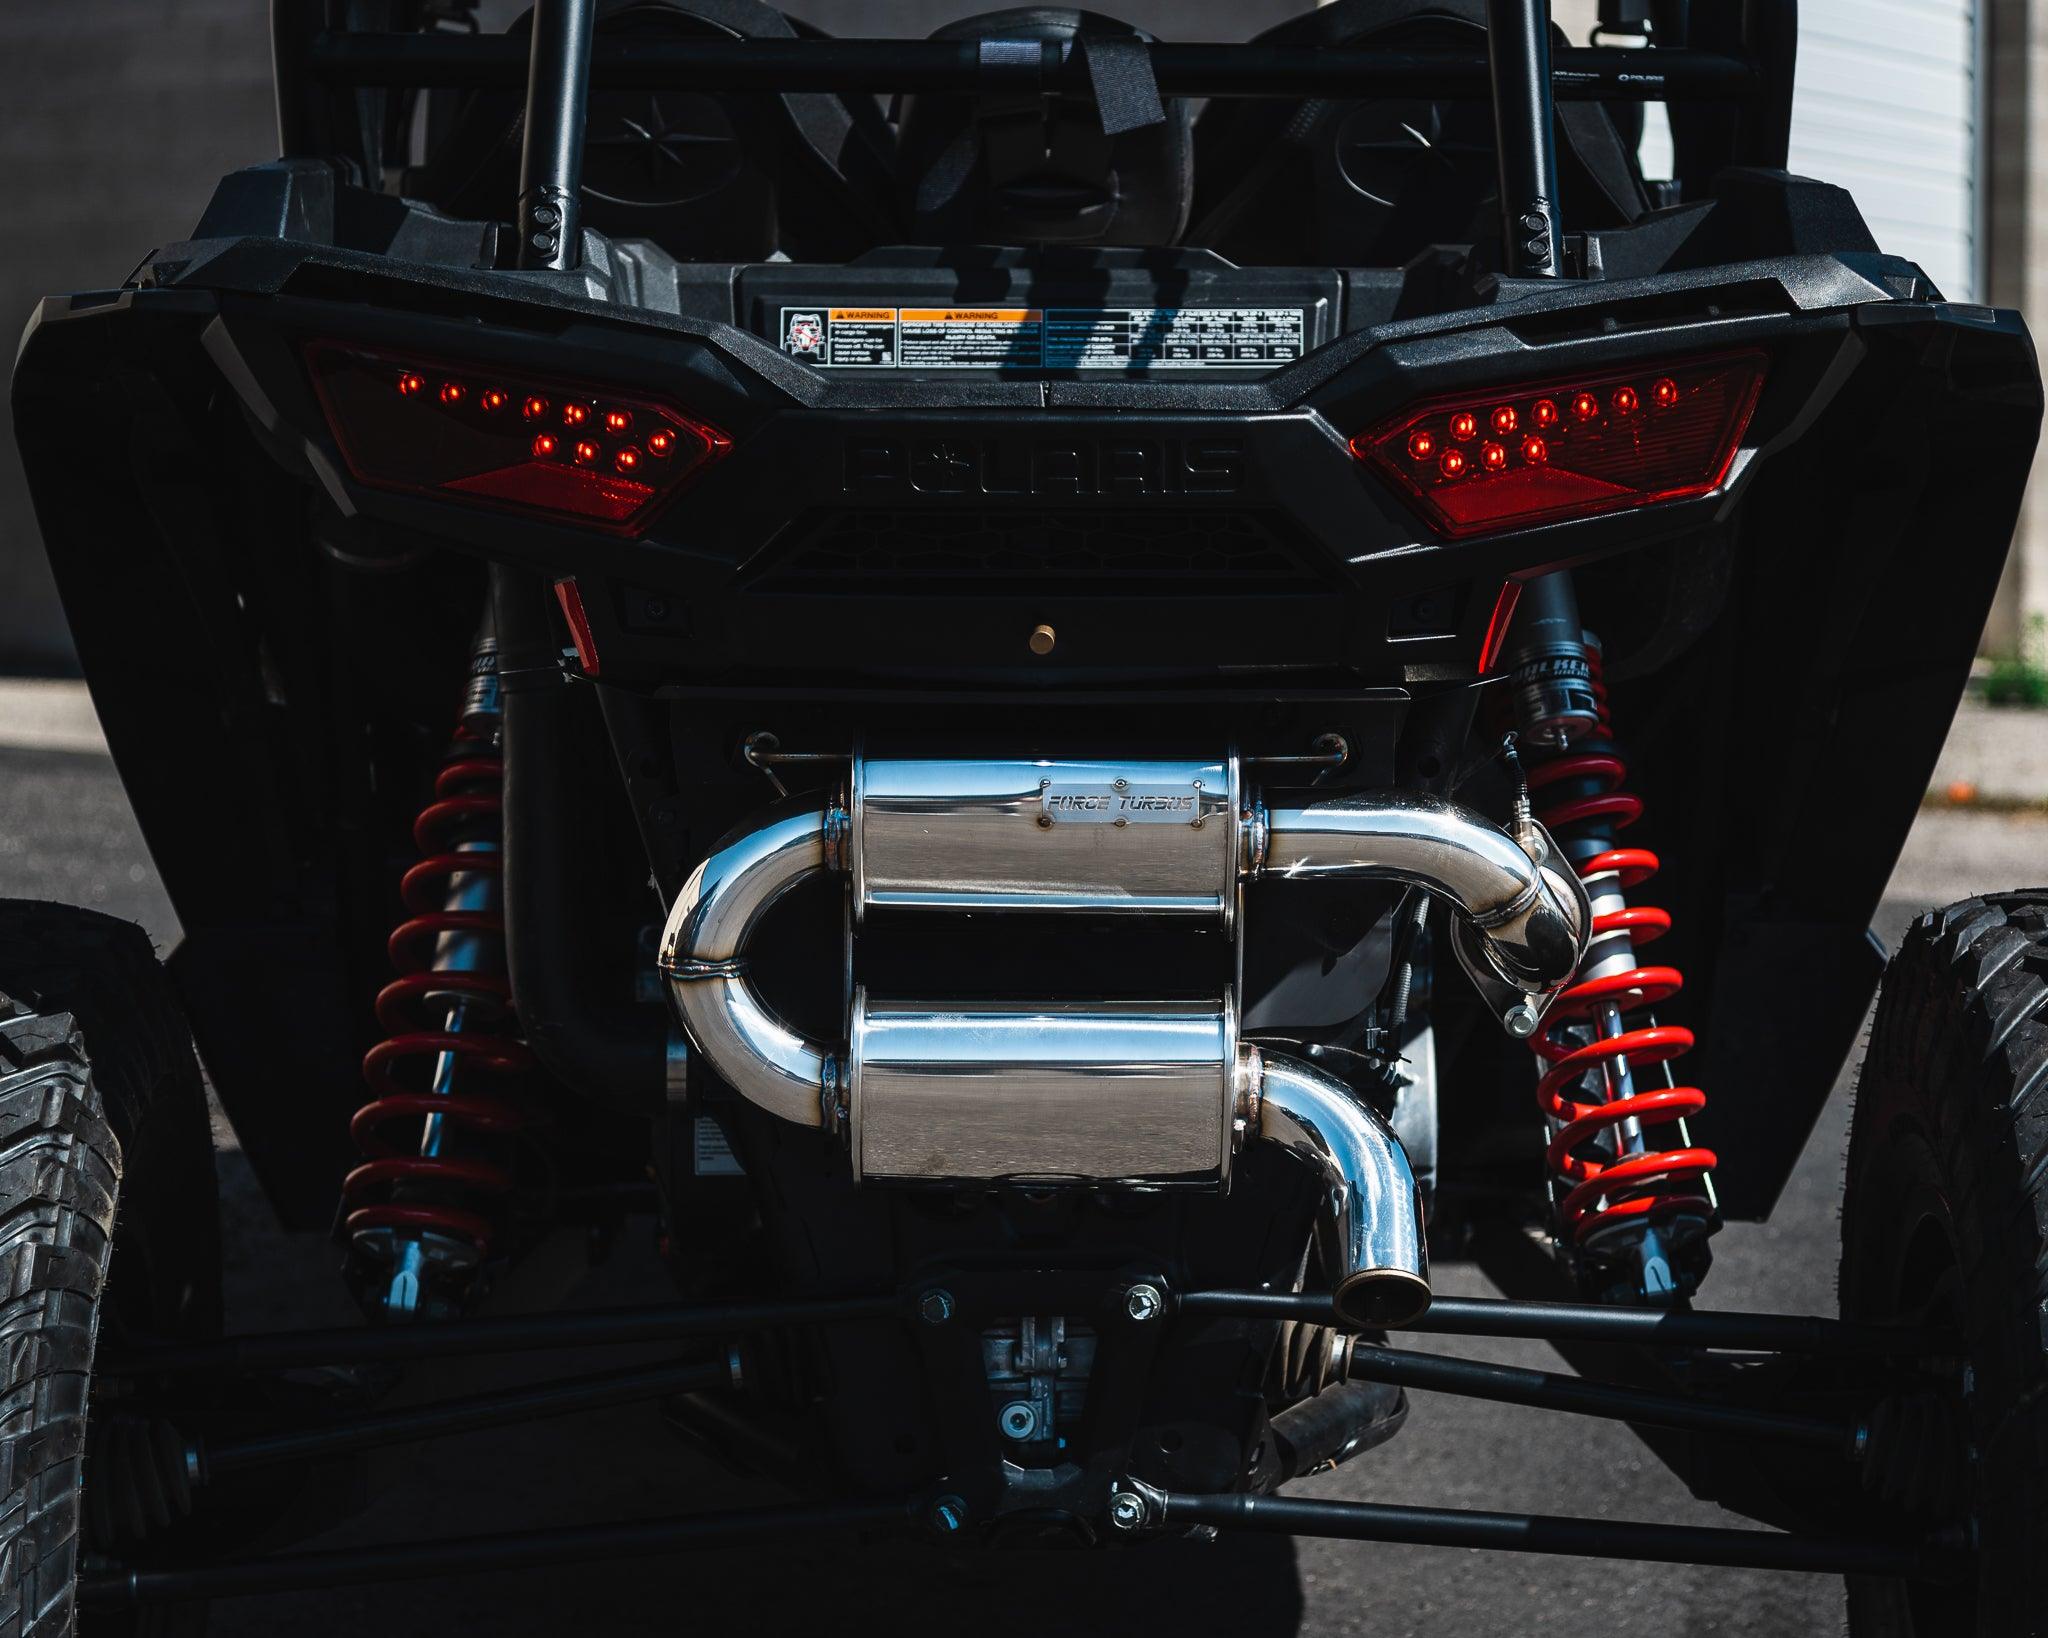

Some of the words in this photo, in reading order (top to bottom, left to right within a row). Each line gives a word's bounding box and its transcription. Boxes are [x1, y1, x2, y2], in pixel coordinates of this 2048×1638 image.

[846, 311, 889, 319] WARNING
[841, 437, 1245, 495] POLARIS
[1047, 796, 1111, 811] FORCE
[1119, 796, 1195, 811] TURBOS
